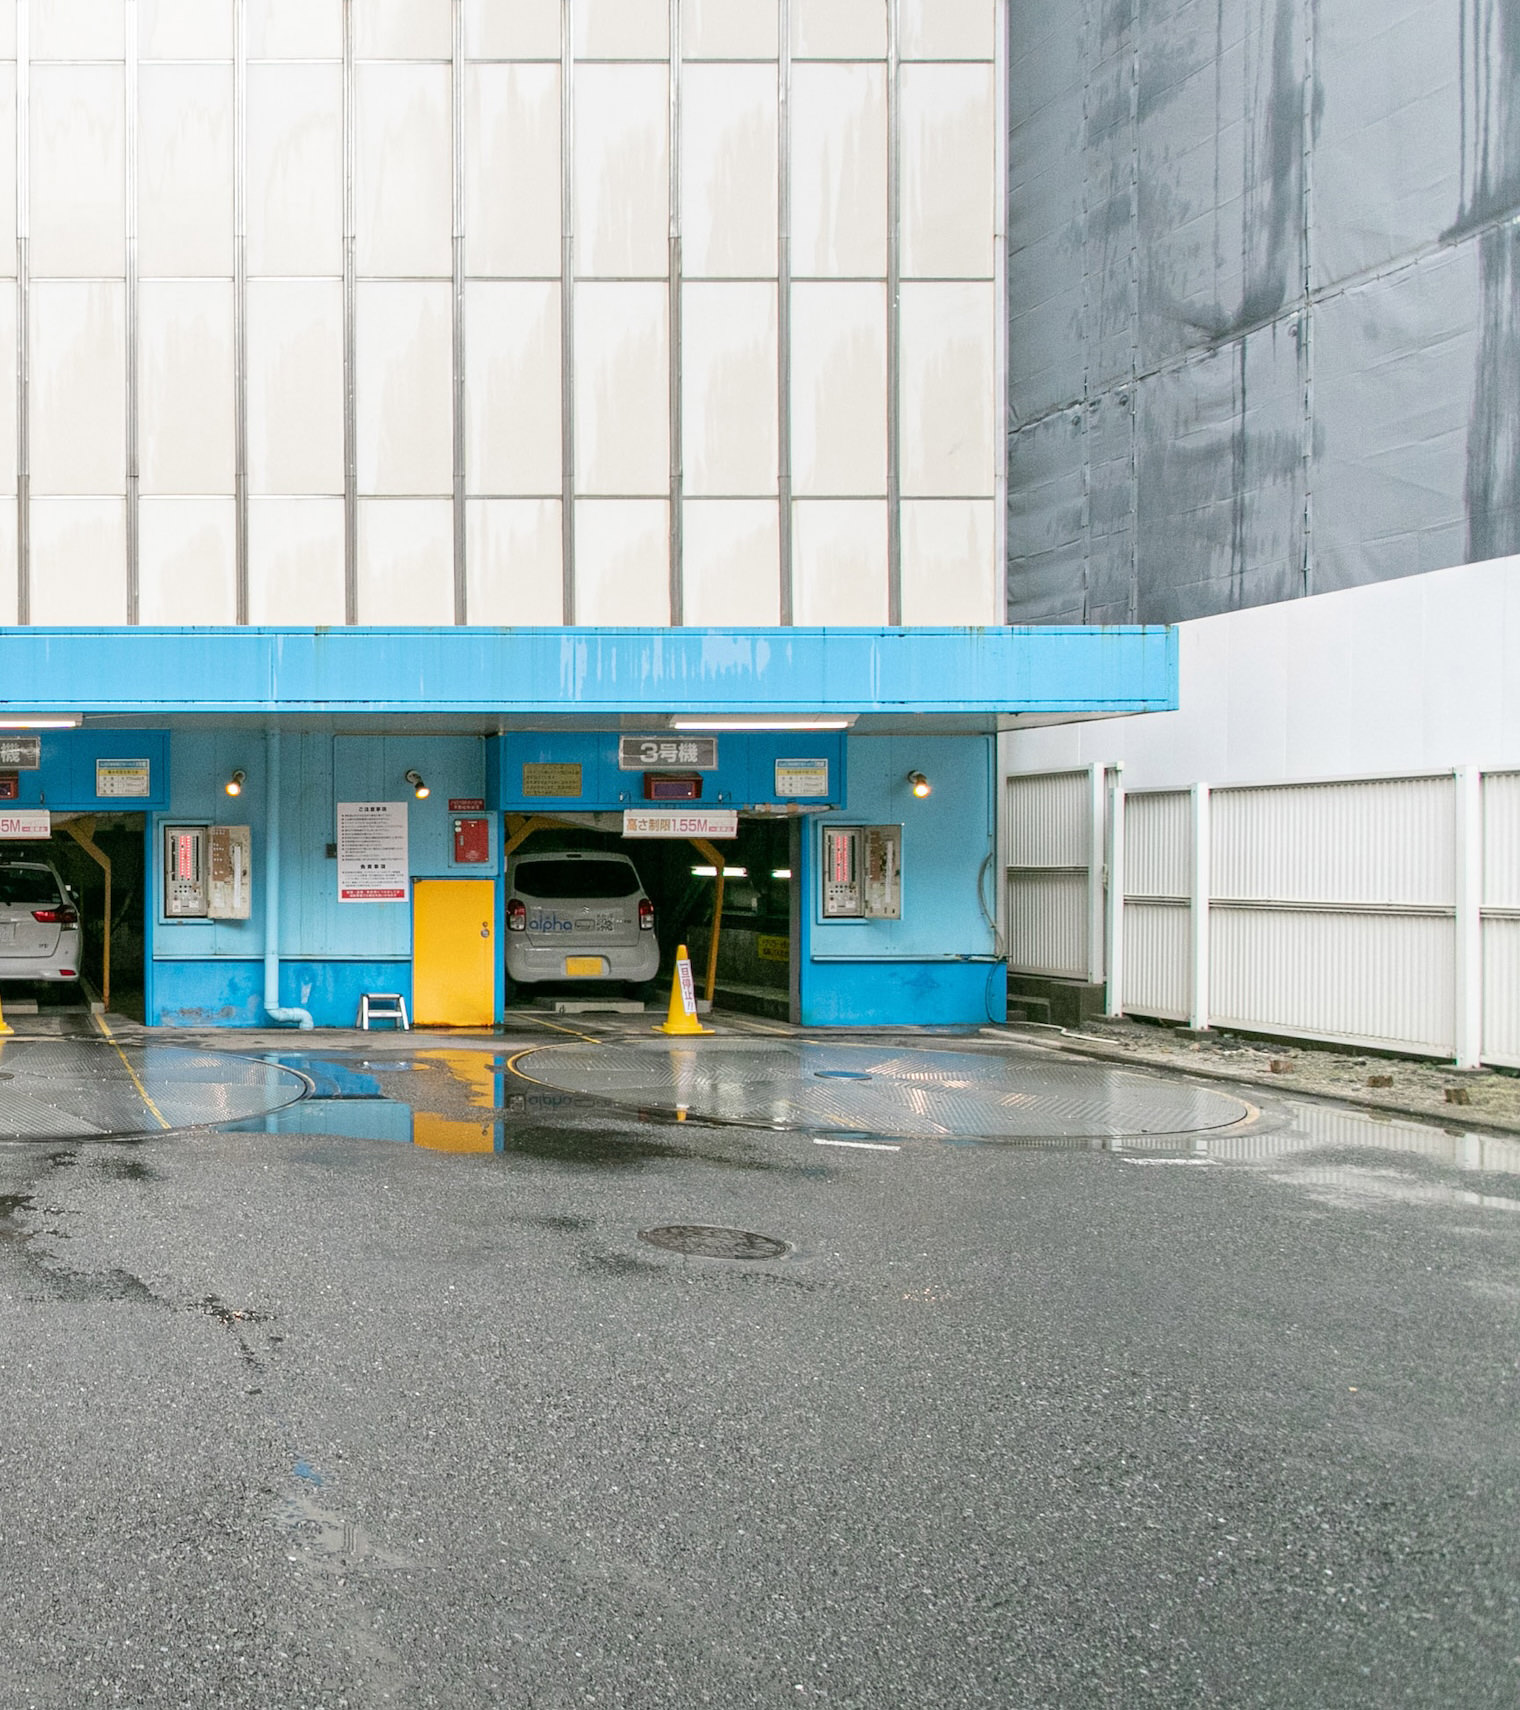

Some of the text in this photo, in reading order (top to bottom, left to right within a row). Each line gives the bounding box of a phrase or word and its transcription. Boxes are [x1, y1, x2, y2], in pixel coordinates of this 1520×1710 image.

[640, 743, 698, 763] 3号機
[626, 818, 708, 833] 高さ制限1.55M
[529, 911, 573, 932] alpha
